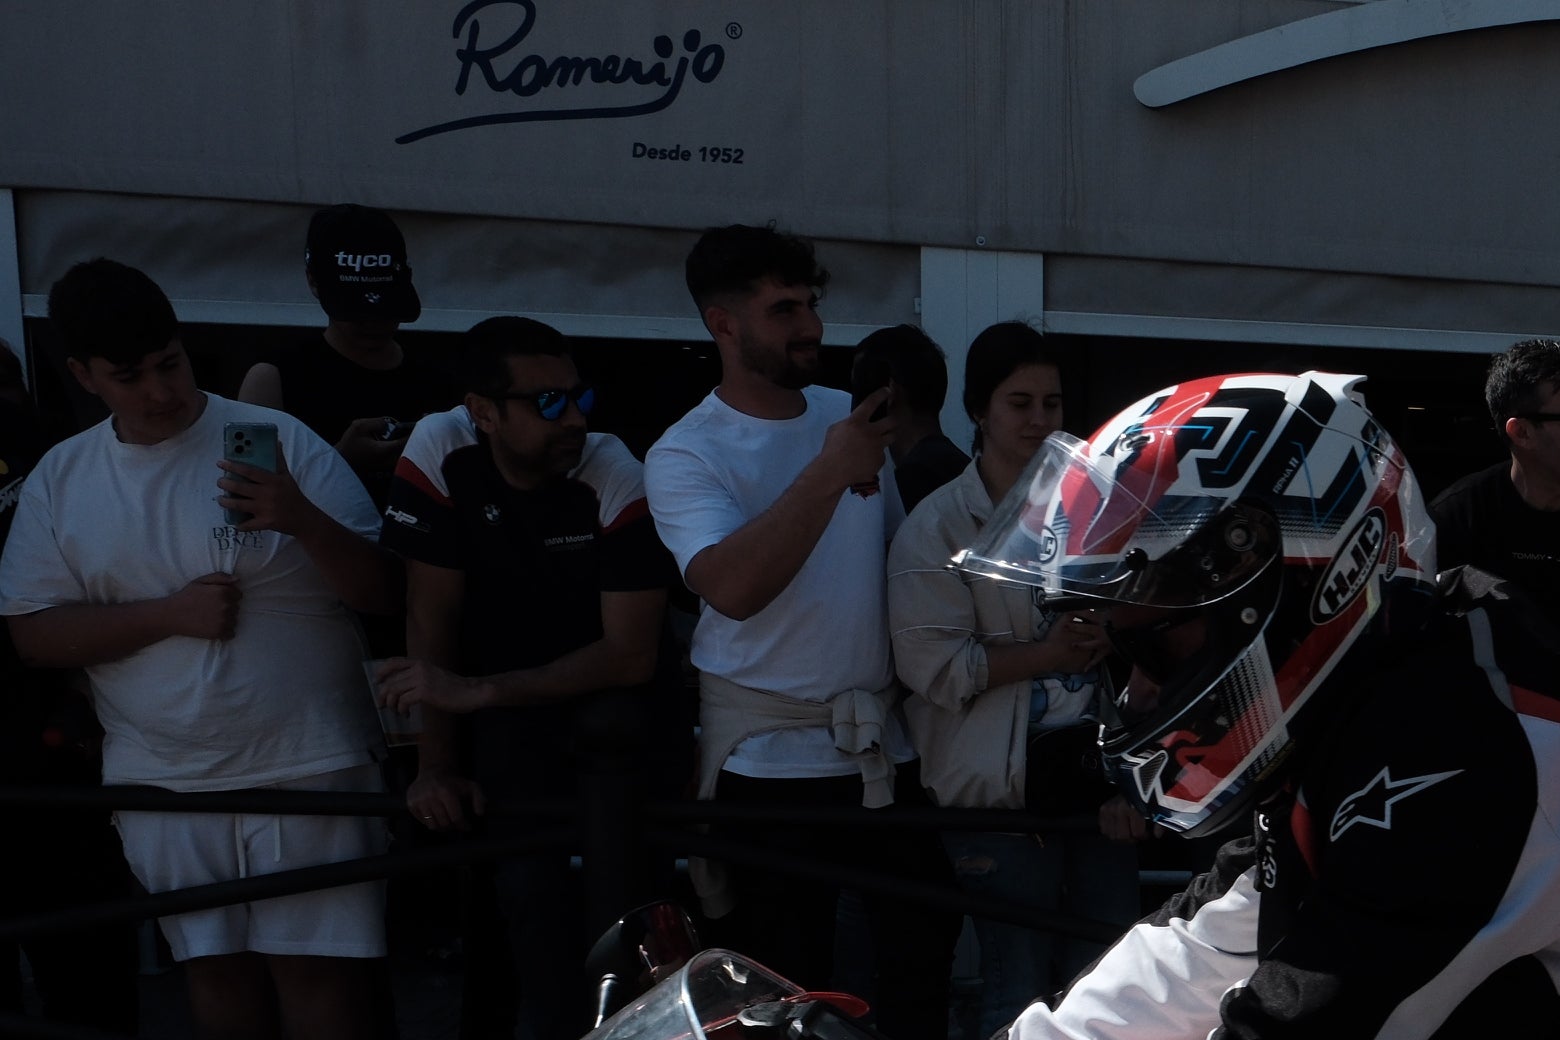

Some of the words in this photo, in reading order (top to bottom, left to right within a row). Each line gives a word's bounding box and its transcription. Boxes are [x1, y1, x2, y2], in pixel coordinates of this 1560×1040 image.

[632, 142, 691, 162] Desde
[698, 146, 745, 164] 1952
[335, 251, 392, 272] tyco
[1322, 516, 1381, 614] HJC
[1511, 552, 1545, 561] TOMMY
